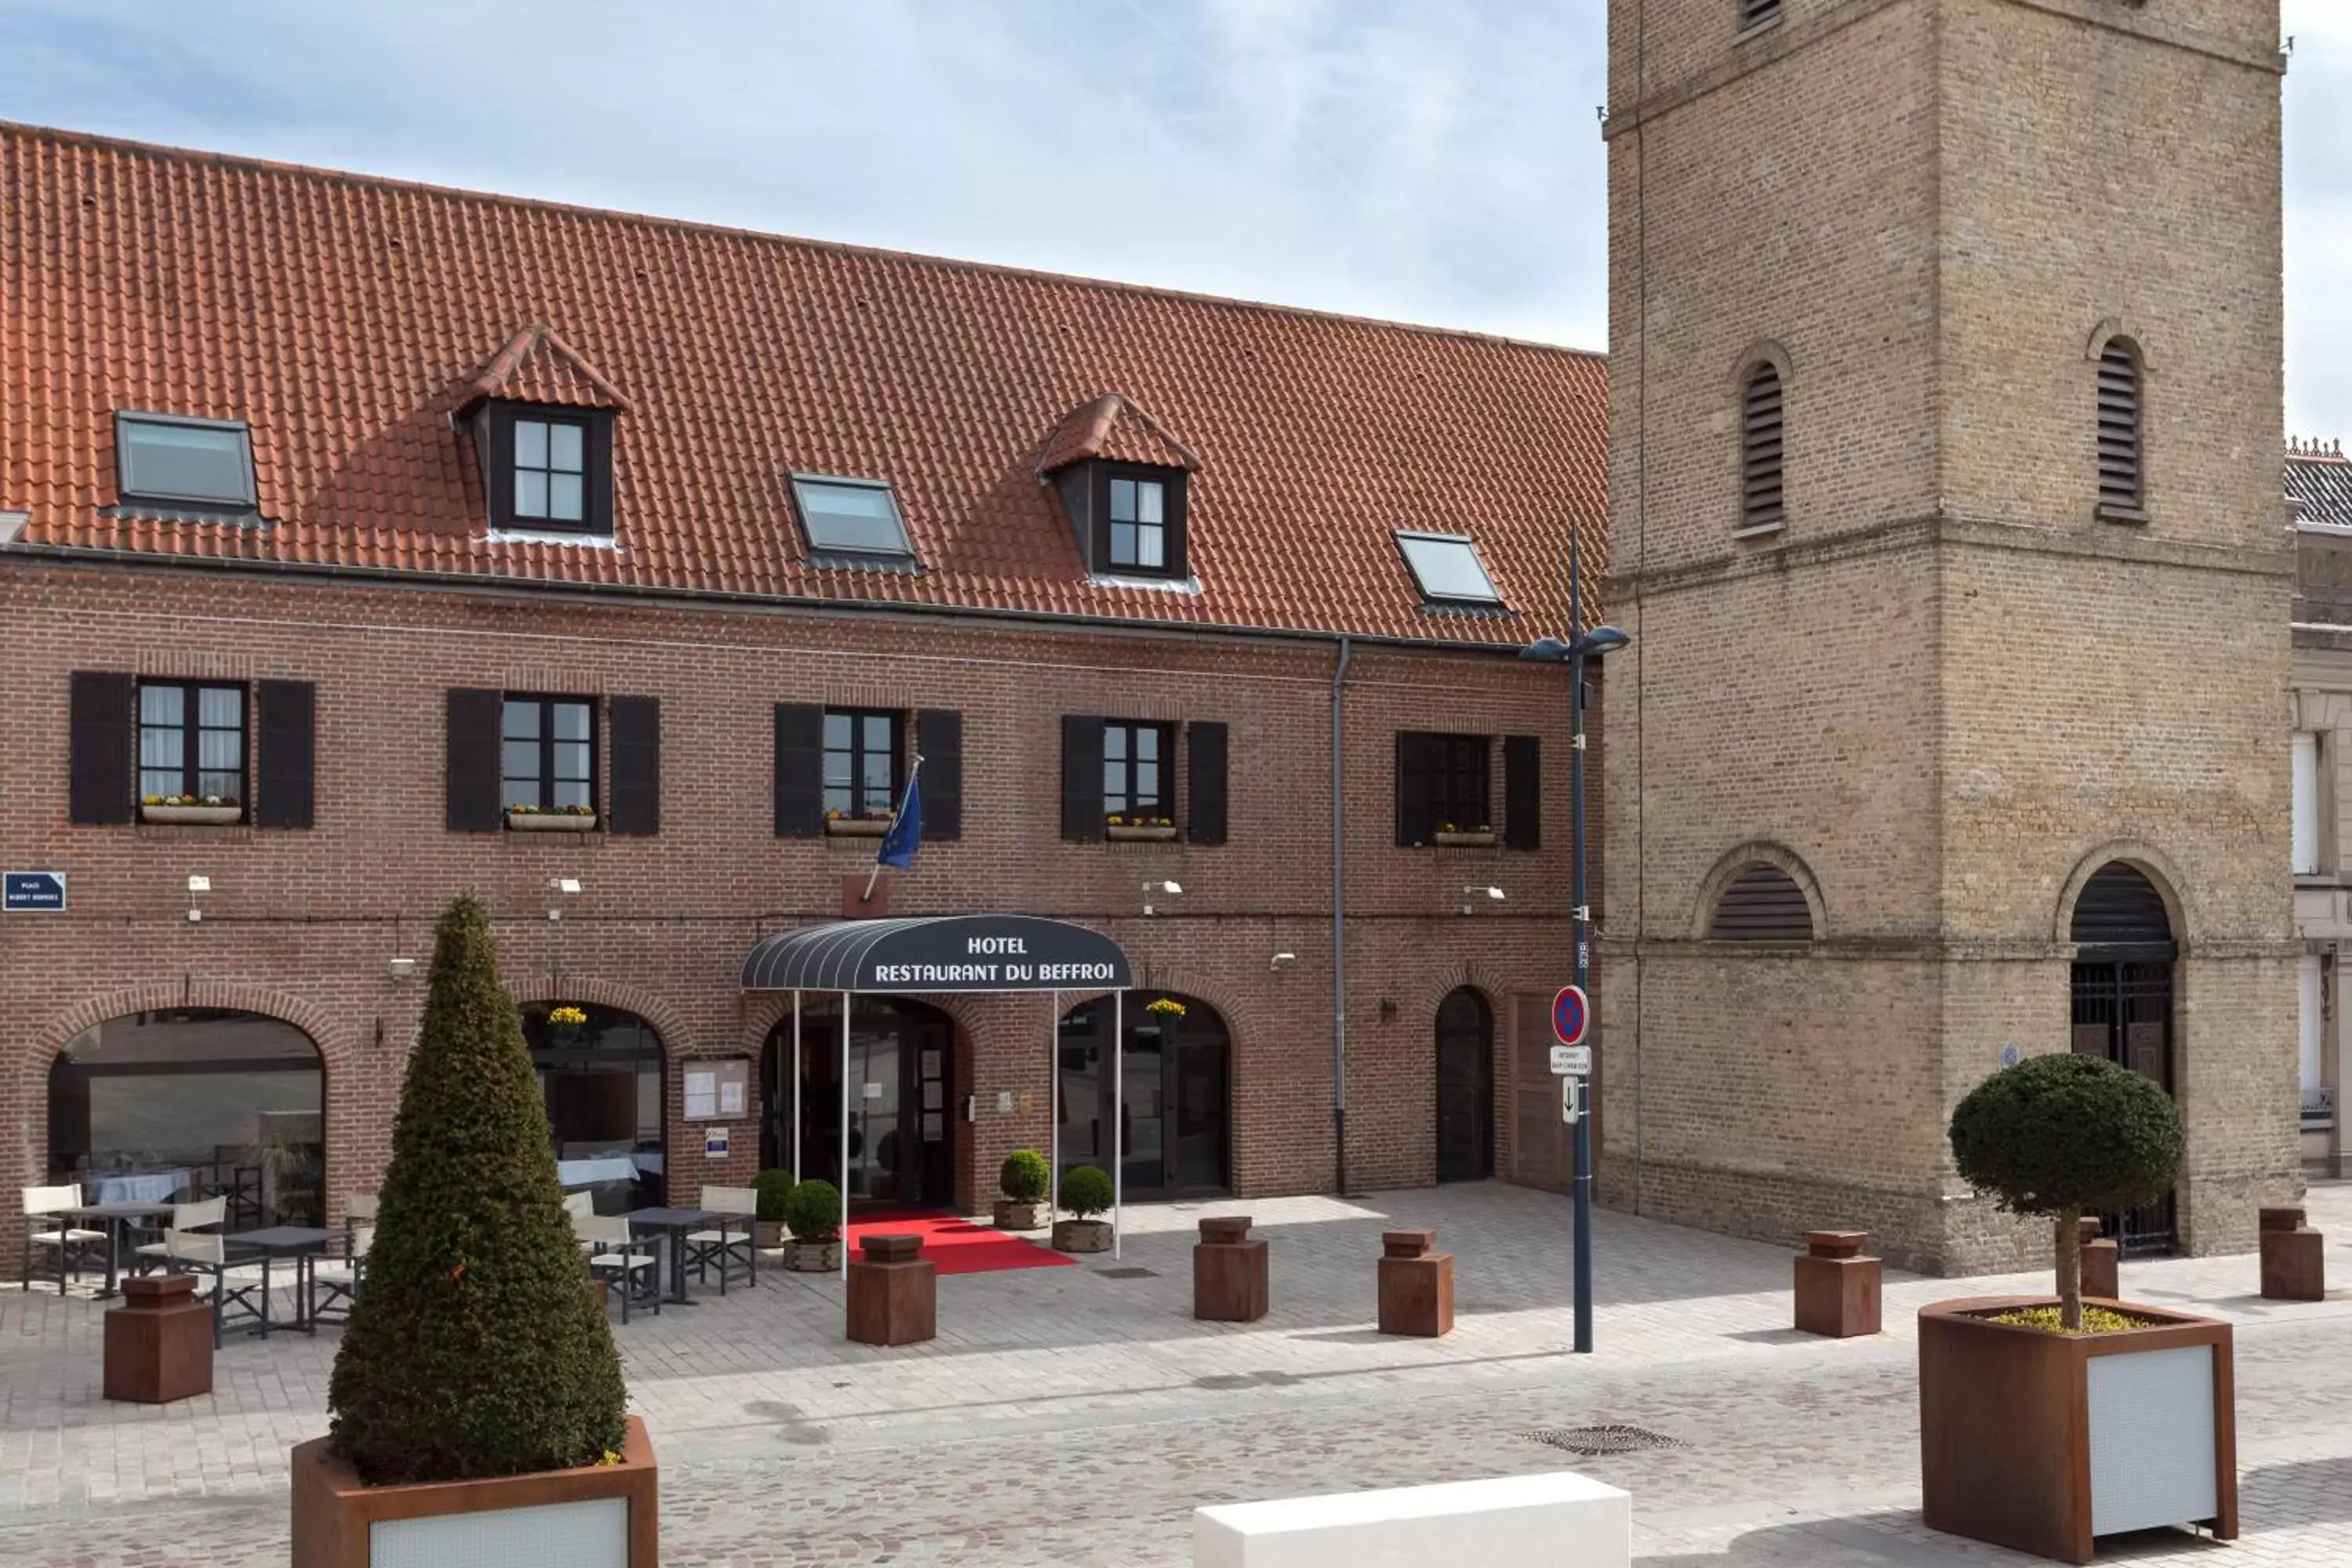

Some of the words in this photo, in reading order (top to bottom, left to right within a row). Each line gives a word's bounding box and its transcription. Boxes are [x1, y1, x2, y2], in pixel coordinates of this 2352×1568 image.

[967, 937, 1028, 954] HOTEL
[875, 964, 999, 982] RESTAURANT
[1006, 964, 1033, 981] DU
[1039, 963, 1114, 980] BEFFROI
